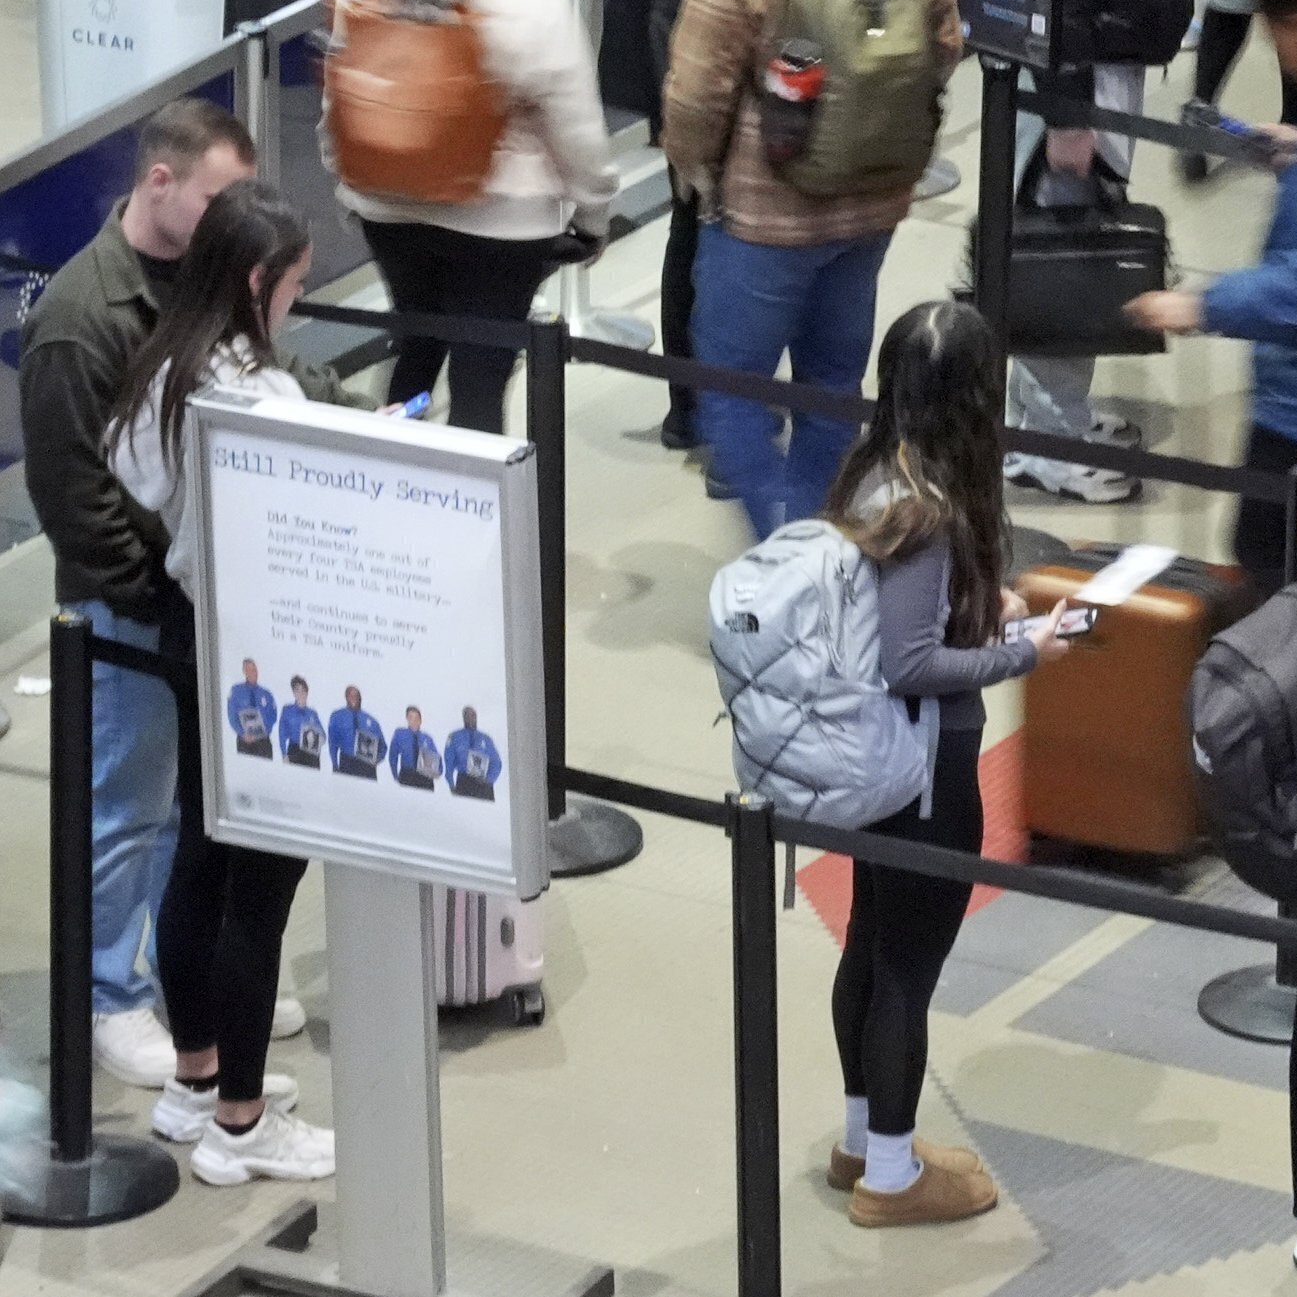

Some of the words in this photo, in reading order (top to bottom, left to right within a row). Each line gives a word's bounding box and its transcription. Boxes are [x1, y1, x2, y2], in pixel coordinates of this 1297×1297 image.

[72, 28, 134, 51] CLEAR
[213, 445, 278, 477] Still
[288, 459, 385, 501] Proudly
[396, 479, 495, 522] Serving
[267, 511, 288, 525] Did
[293, 516, 315, 530] You
[321, 521, 358, 536] Know?
[267, 528, 359, 556] Approximately
[365, 547, 385, 561] one
[390, 551, 412, 566] out
[417, 557, 432, 569] of
[267, 545, 303, 563] every
[309, 551, 336, 567] four
[344, 557, 365, 572] TSA
[370, 564, 432, 586] employees
[267, 562, 309, 579] served
[315, 568, 329, 582] in
[336, 572, 356, 588] the
[270, 610, 303, 627] their
[308, 618, 359, 642] Country
[365, 630, 415, 650] proudly
[306, 602, 369, 624] continues
[374, 614, 388, 626] to
[392, 619, 428, 635] serve
[271, 627, 285, 640] in
[303, 632, 324, 648] TSA
[330, 639, 385, 659] uniform.
